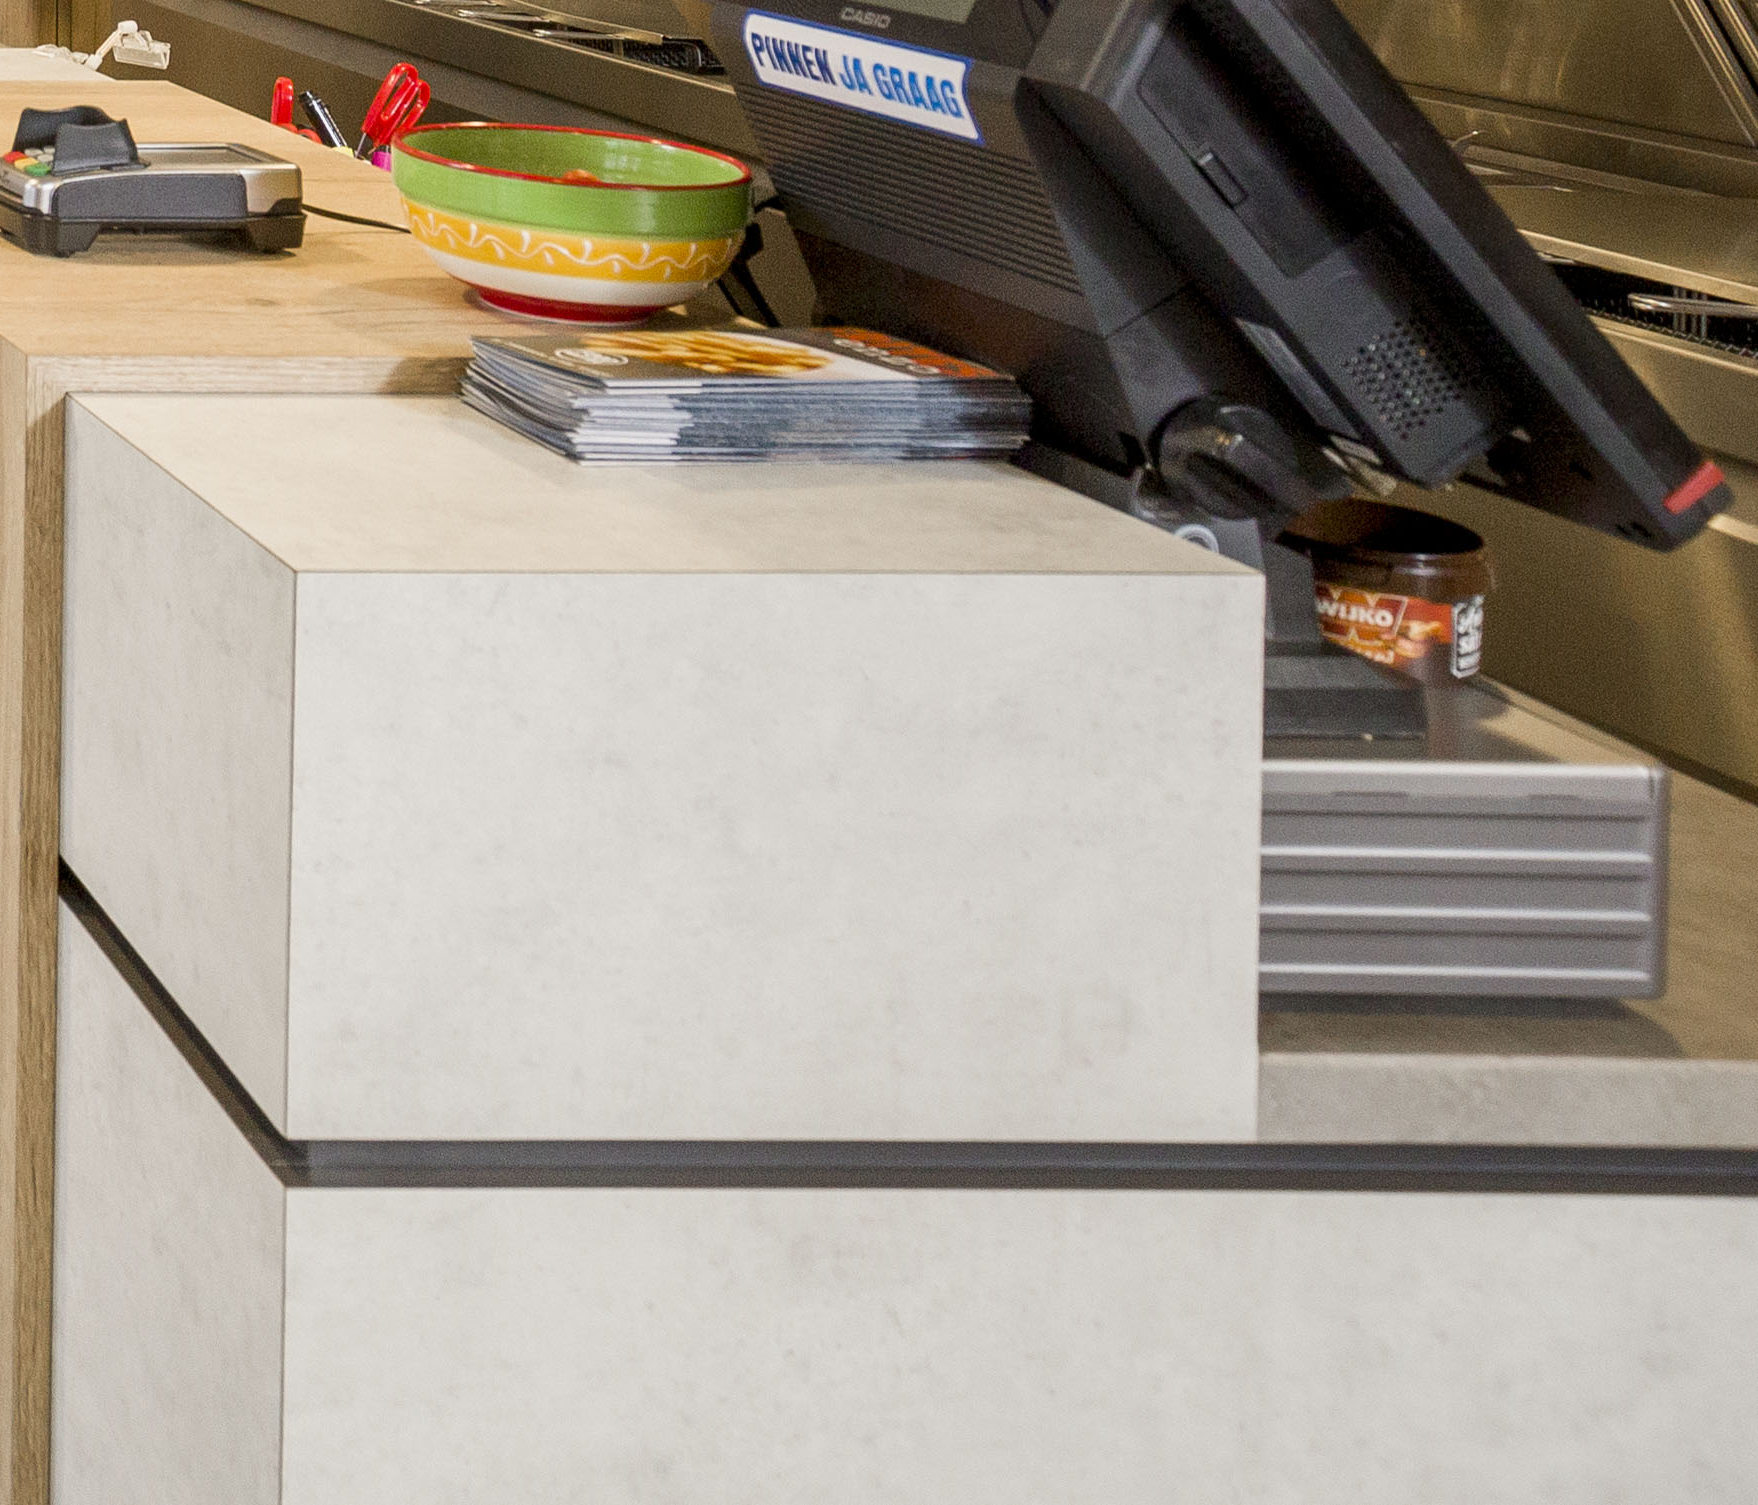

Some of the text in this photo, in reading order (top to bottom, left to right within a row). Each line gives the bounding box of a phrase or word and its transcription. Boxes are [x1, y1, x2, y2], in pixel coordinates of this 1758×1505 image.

[839, 7, 892, 29] CASIO
[750, 32, 965, 119] PINNEN JA GRAAG
